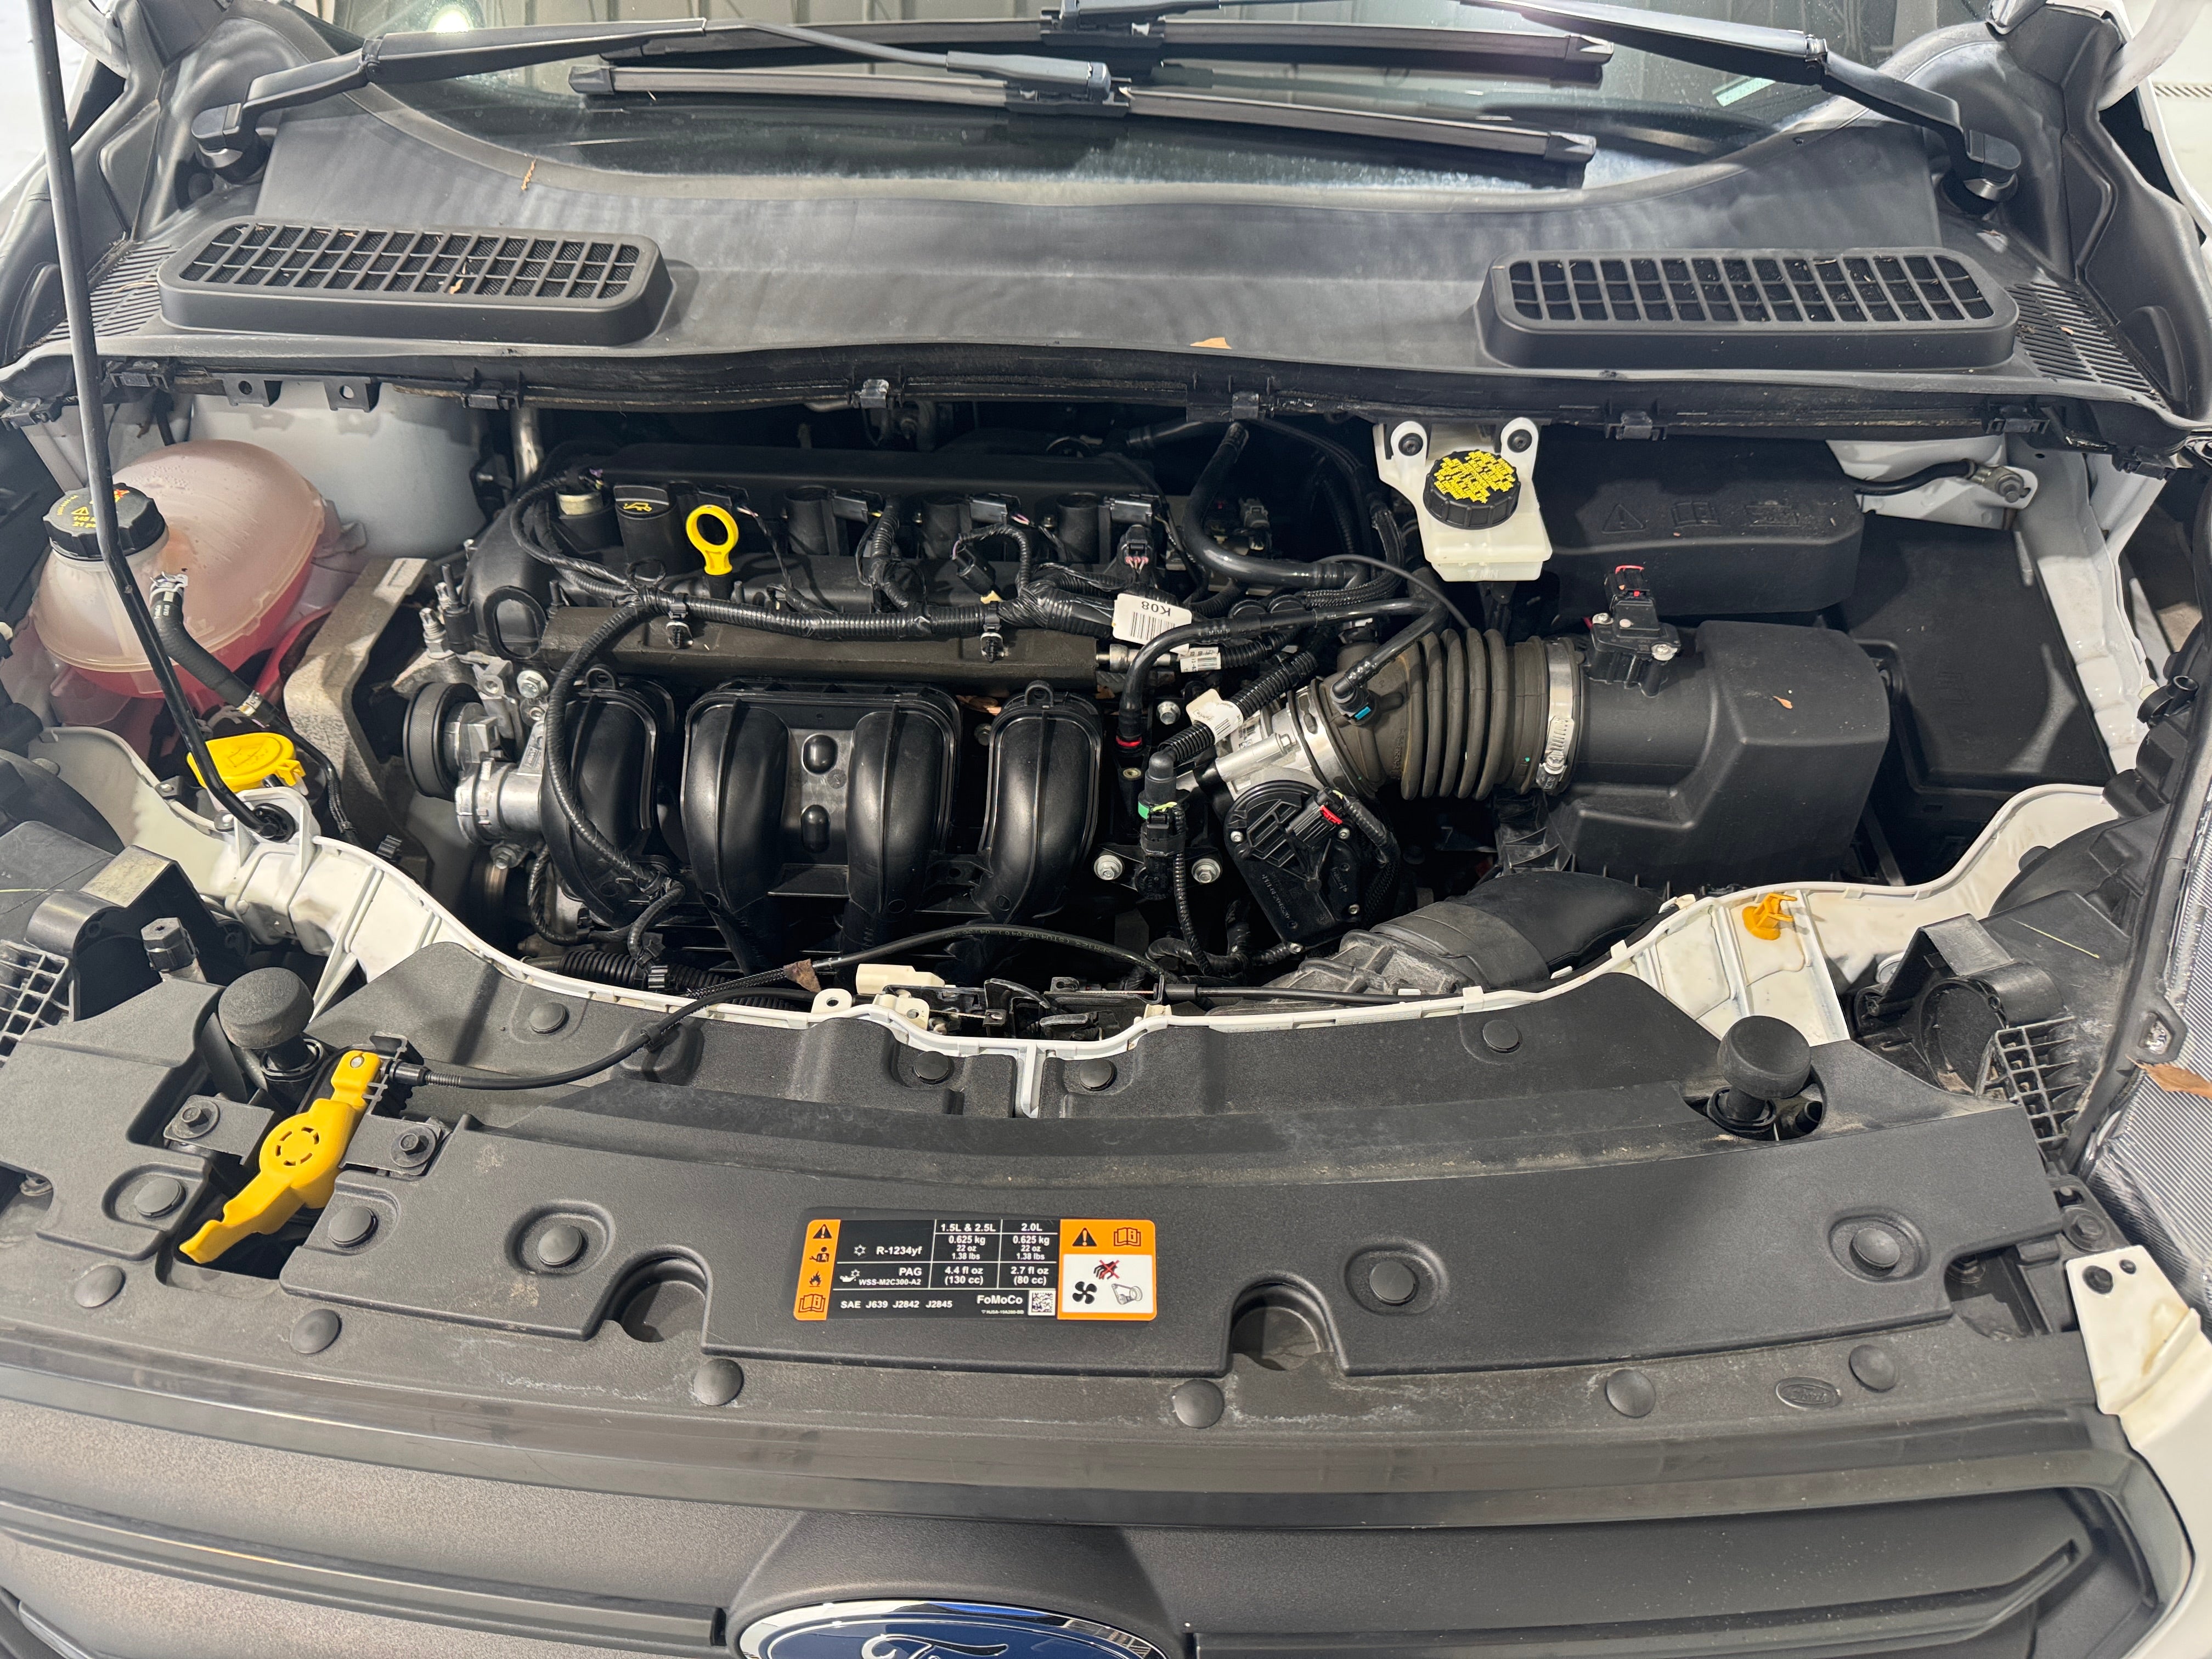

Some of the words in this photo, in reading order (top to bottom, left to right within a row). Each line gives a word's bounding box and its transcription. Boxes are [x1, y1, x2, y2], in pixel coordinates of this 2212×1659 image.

[1141, 1149, 1171, 1165] K08
[941, 1223, 961, 1232] 1.5L
[974, 1223, 996, 1232] 2.5L
[1021, 1223, 1042, 1232] 2.0L
[949, 1235, 972, 1244] 0.625
[974, 1235, 986, 1246] kg
[1013, 1235, 1036, 1244] 0.625
[1039, 1235, 1050, 1246] kg
[876, 1246, 922, 1257] R-1234yf
[899, 1267, 922, 1276] PAG
[945, 1266, 960, 1274] 4.4
[962, 1266, 969, 1274] fl
[1011, 1266, 1025, 1274] 2.7
[1028, 1266, 1035, 1274] fl
[945, 1276, 966, 1286] (130
[968, 1276, 984, 1286] cc)
[1014, 1276, 1029, 1286] (80
[1031, 1276, 1047, 1286] cc)
[840, 1300, 861, 1308] SAE
[865, 1300, 888, 1308] J639
[893, 1300, 919, 1308] J2842
[926, 1300, 952, 1308] J2845
[977, 1295, 1023, 1305] FoMoCo
